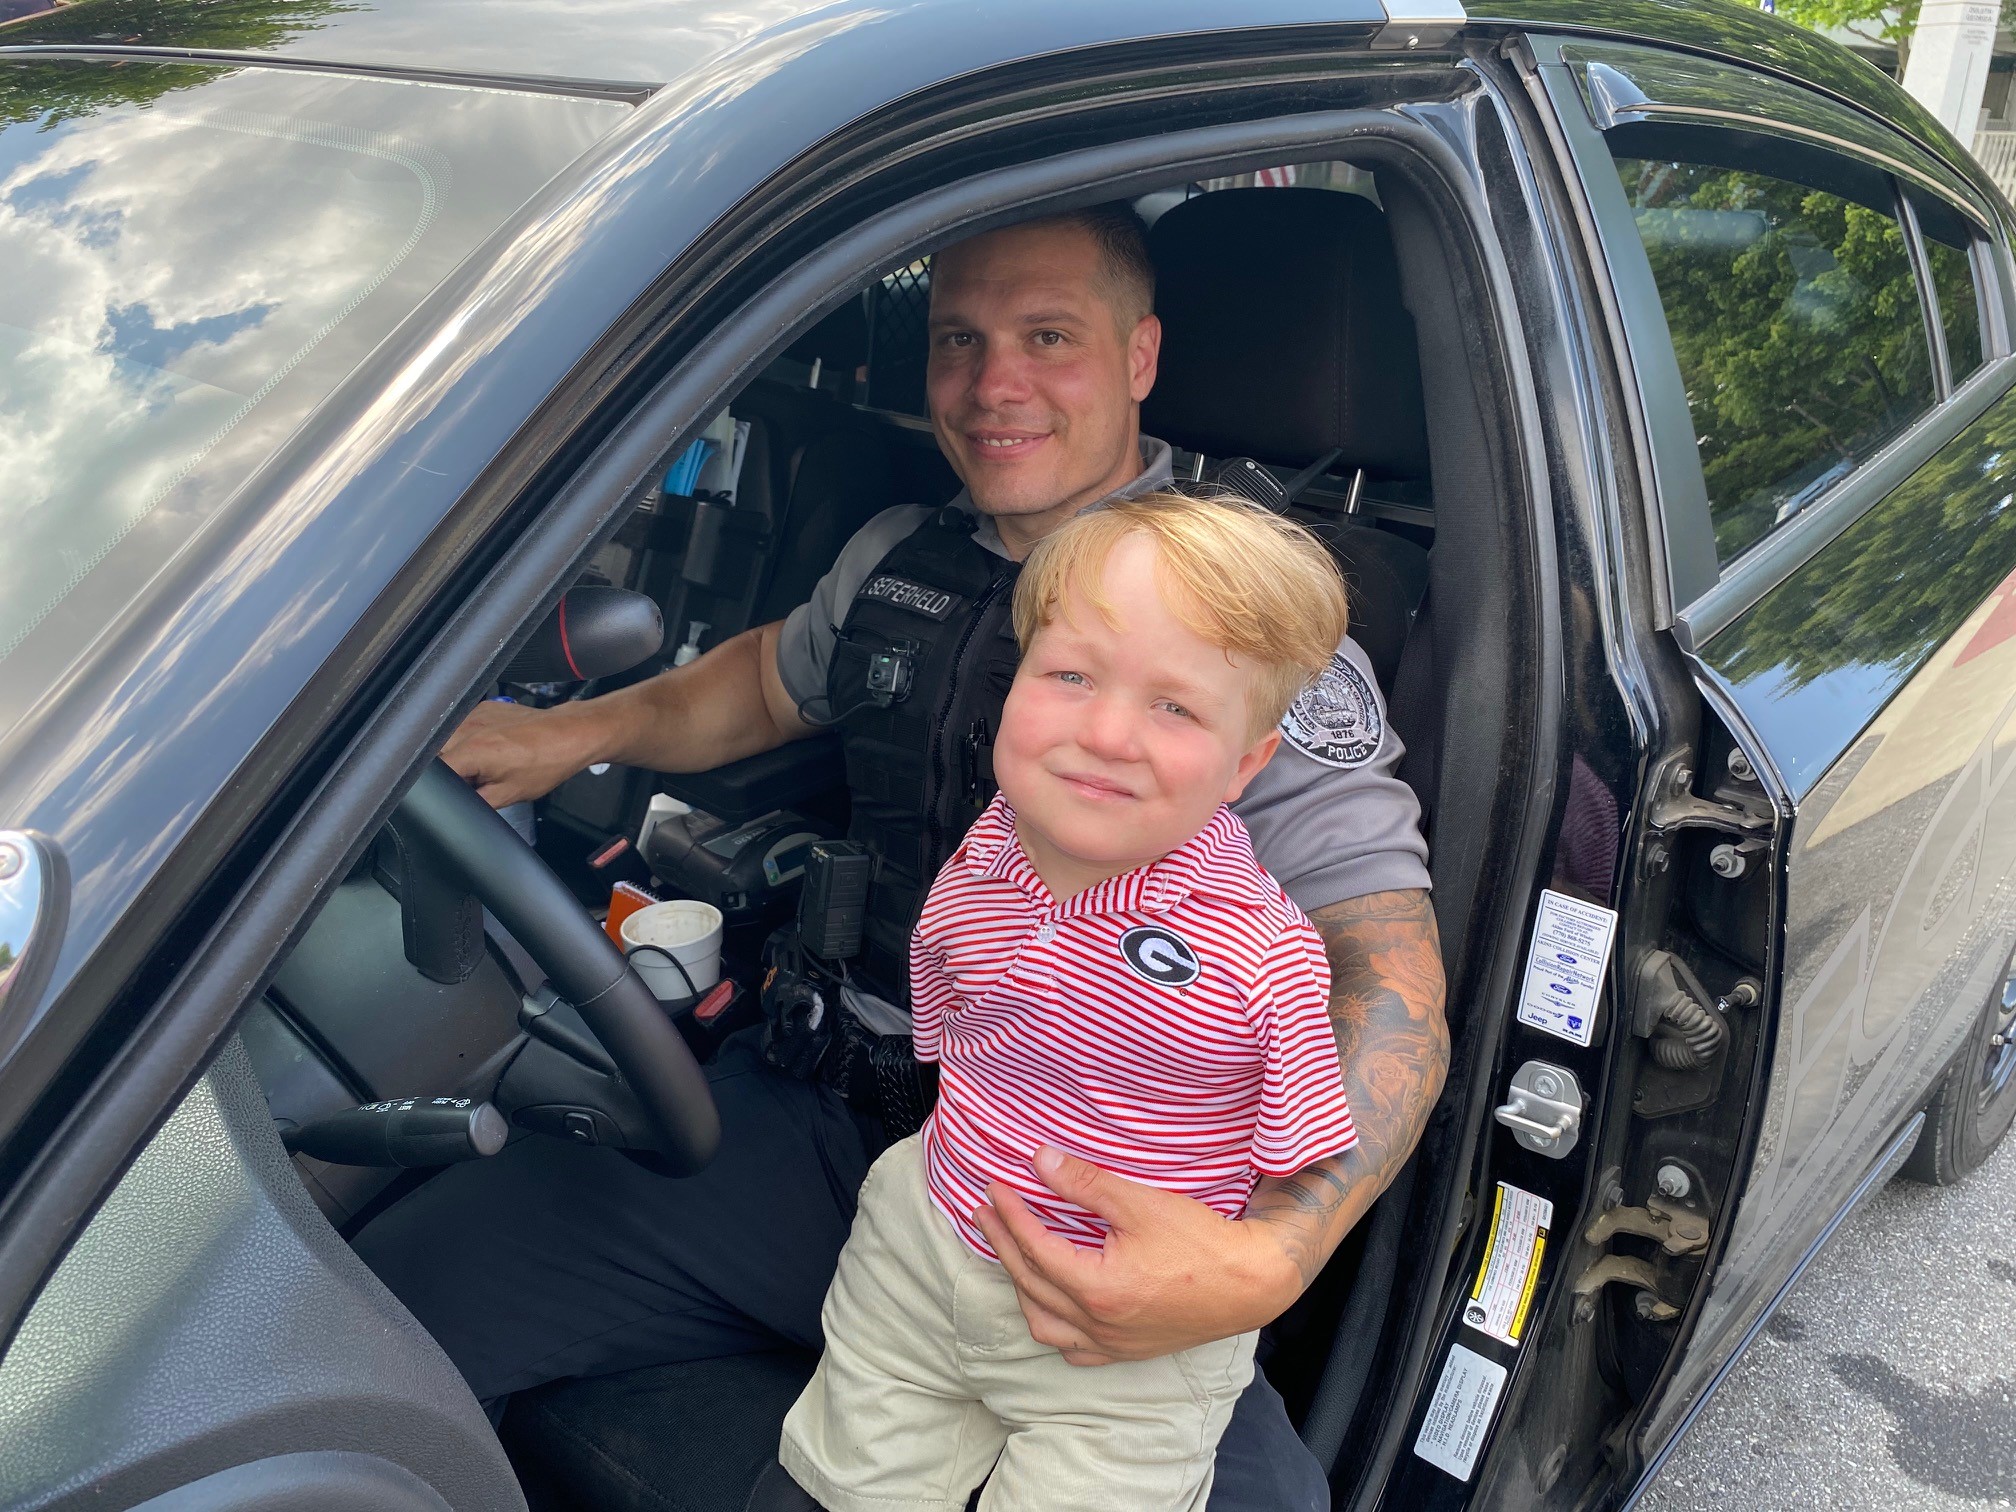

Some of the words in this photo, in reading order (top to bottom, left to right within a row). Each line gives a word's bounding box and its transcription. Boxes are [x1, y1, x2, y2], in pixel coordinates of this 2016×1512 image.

[868, 576, 950, 614] SEIFERHELD
[1300, 710, 1317, 730] SEAL
[1330, 730, 1355, 740] 1876
[1328, 742, 1368, 760] POLICE
[1552, 929, 1566, 938] (770)
[1119, 926, 1200, 986] G
[1527, 1011, 1547, 1025] Jeep
[1456, 1367, 1468, 1390] DISPLAY
[1432, 1424, 1440, 1440] VIDEO
[1437, 1402, 1449, 1424] DISPLAY
[1447, 1398, 1462, 1430] HEADLAMPS
